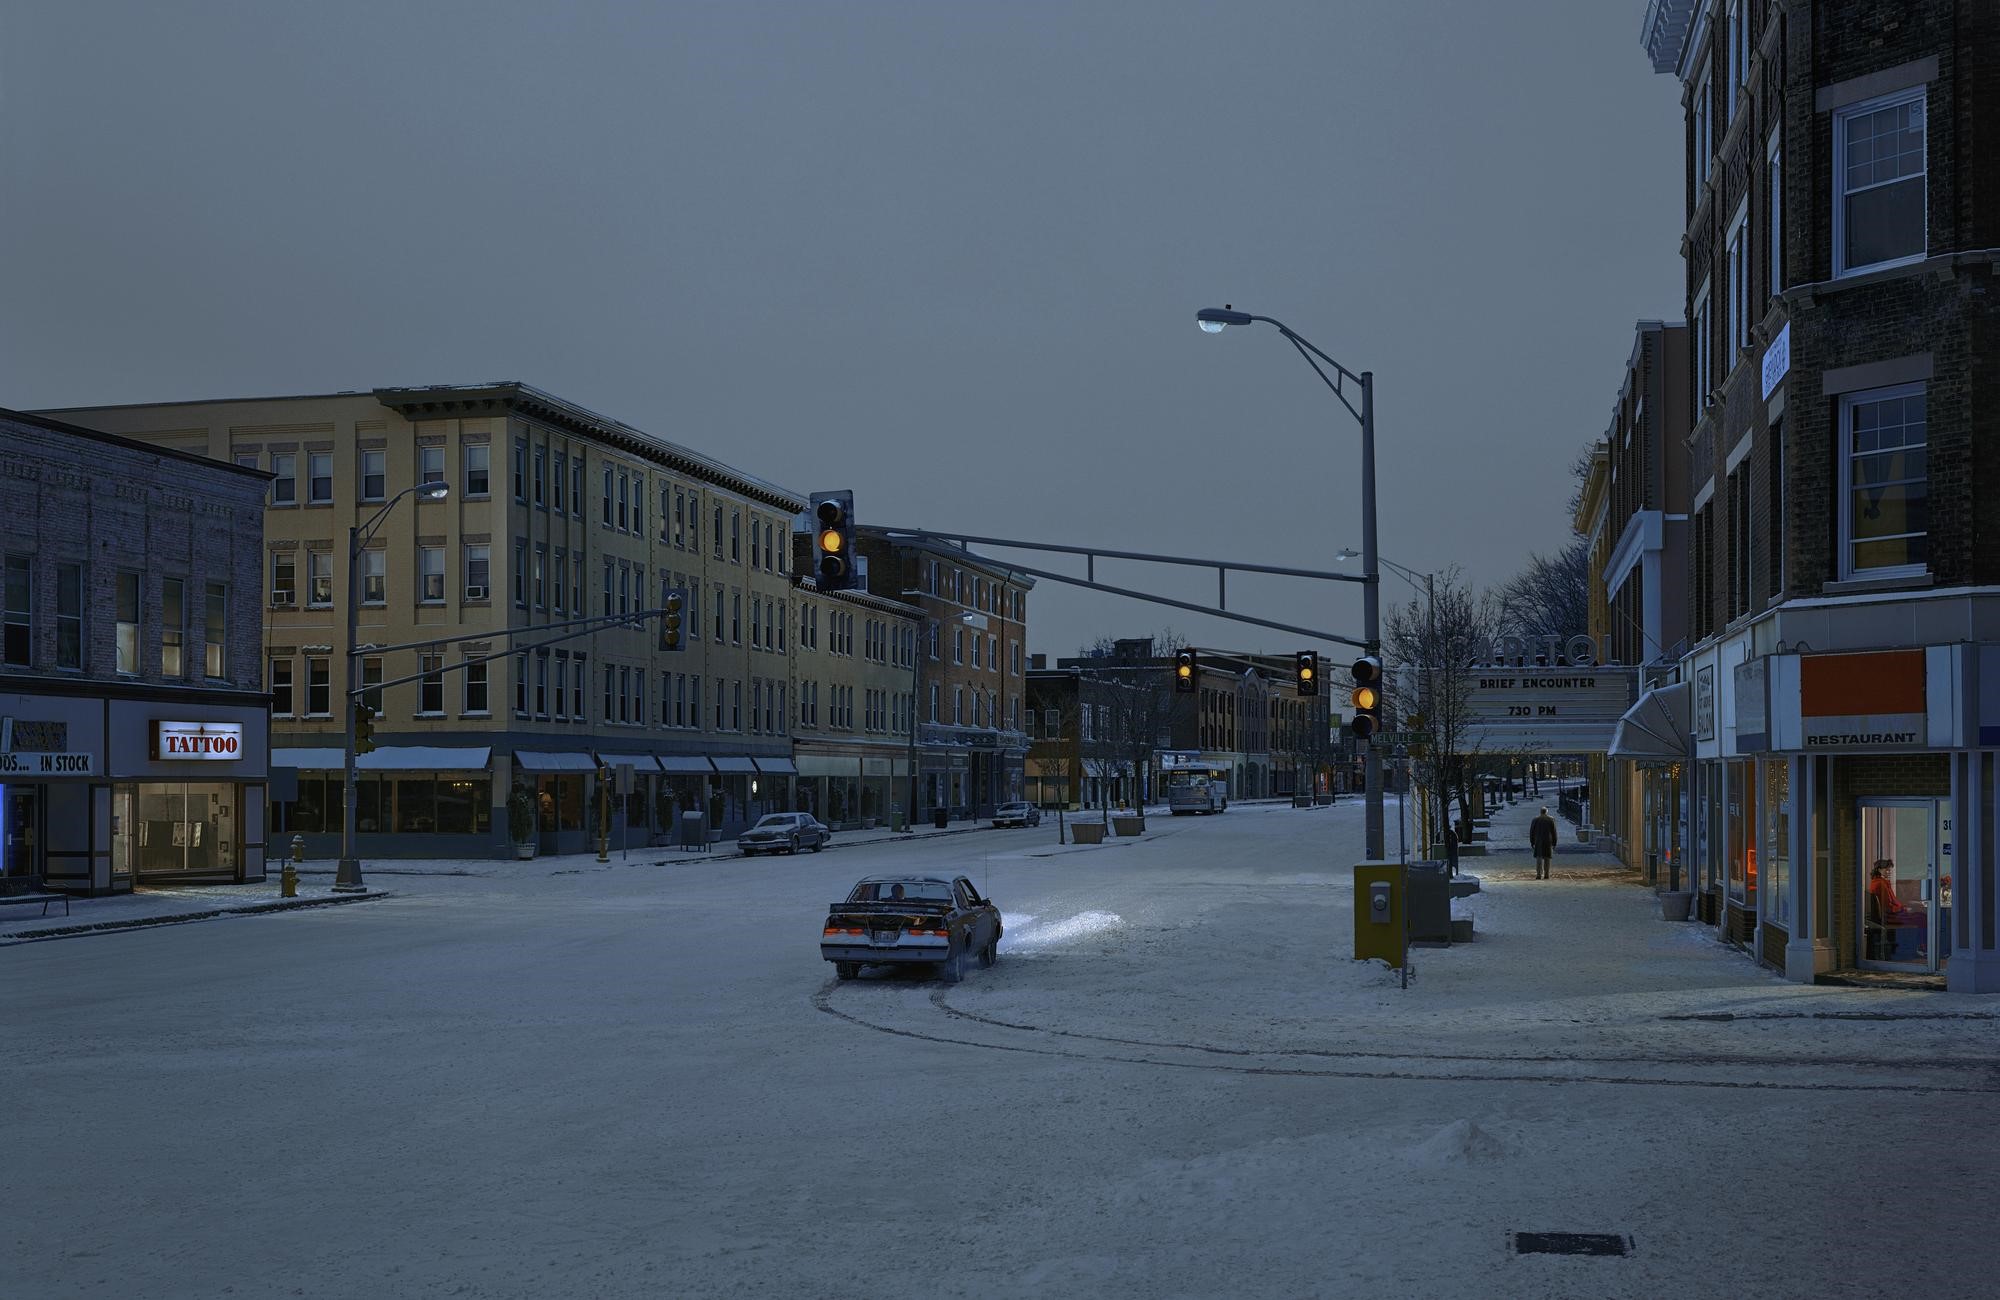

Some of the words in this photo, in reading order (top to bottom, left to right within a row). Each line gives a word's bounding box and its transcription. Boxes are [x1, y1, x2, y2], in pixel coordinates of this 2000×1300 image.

[1480, 678, 1516, 689] BRIEF
[1522, 677, 1596, 688] ENCOUNTER
[1508, 706, 1531, 716] 730
[1538, 706, 1557, 716] PM
[1371, 733, 1413, 744] MELVILLE
[1807, 732, 1917, 745] RESTAURANT
[166, 736, 238, 754] TATTOO
[0, 755, 29, 771] OS...
[41, 755, 52, 771] IN
[56, 755, 89, 771] STOCK
